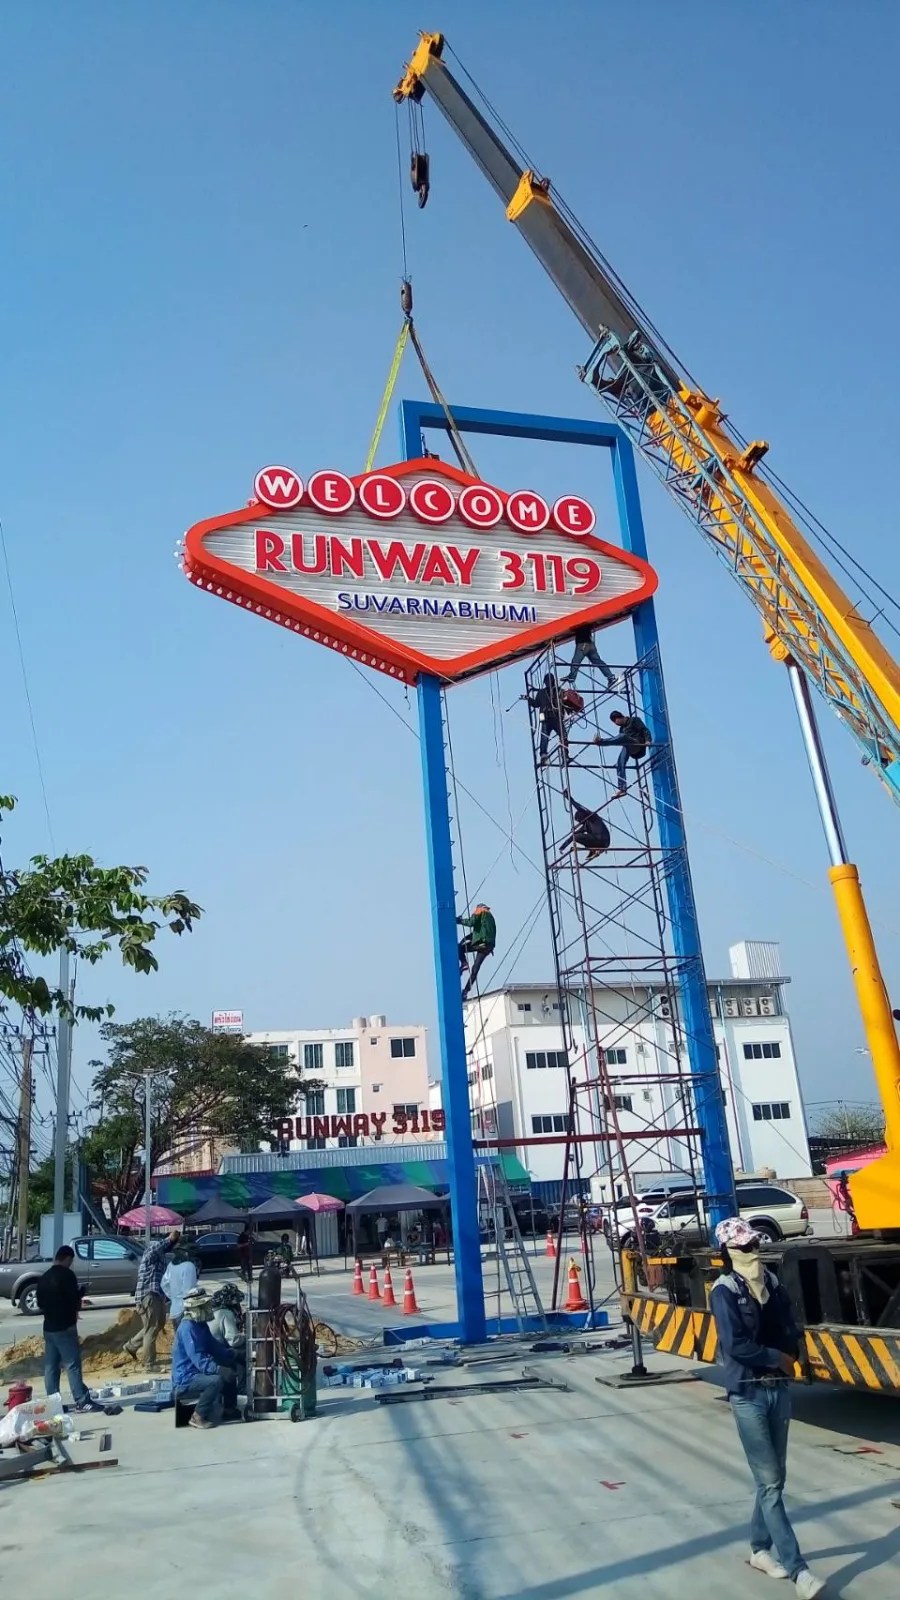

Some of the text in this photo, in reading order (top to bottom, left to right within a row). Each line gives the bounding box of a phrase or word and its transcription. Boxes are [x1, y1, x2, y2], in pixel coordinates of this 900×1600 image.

[259, 471, 585, 528] WELCOME
[254, 528, 602, 596] RUNWAY 3119
[336, 592, 538, 623] SUVARNABHUMI
[276, 1109, 446, 1141] RUNWAY 3119
